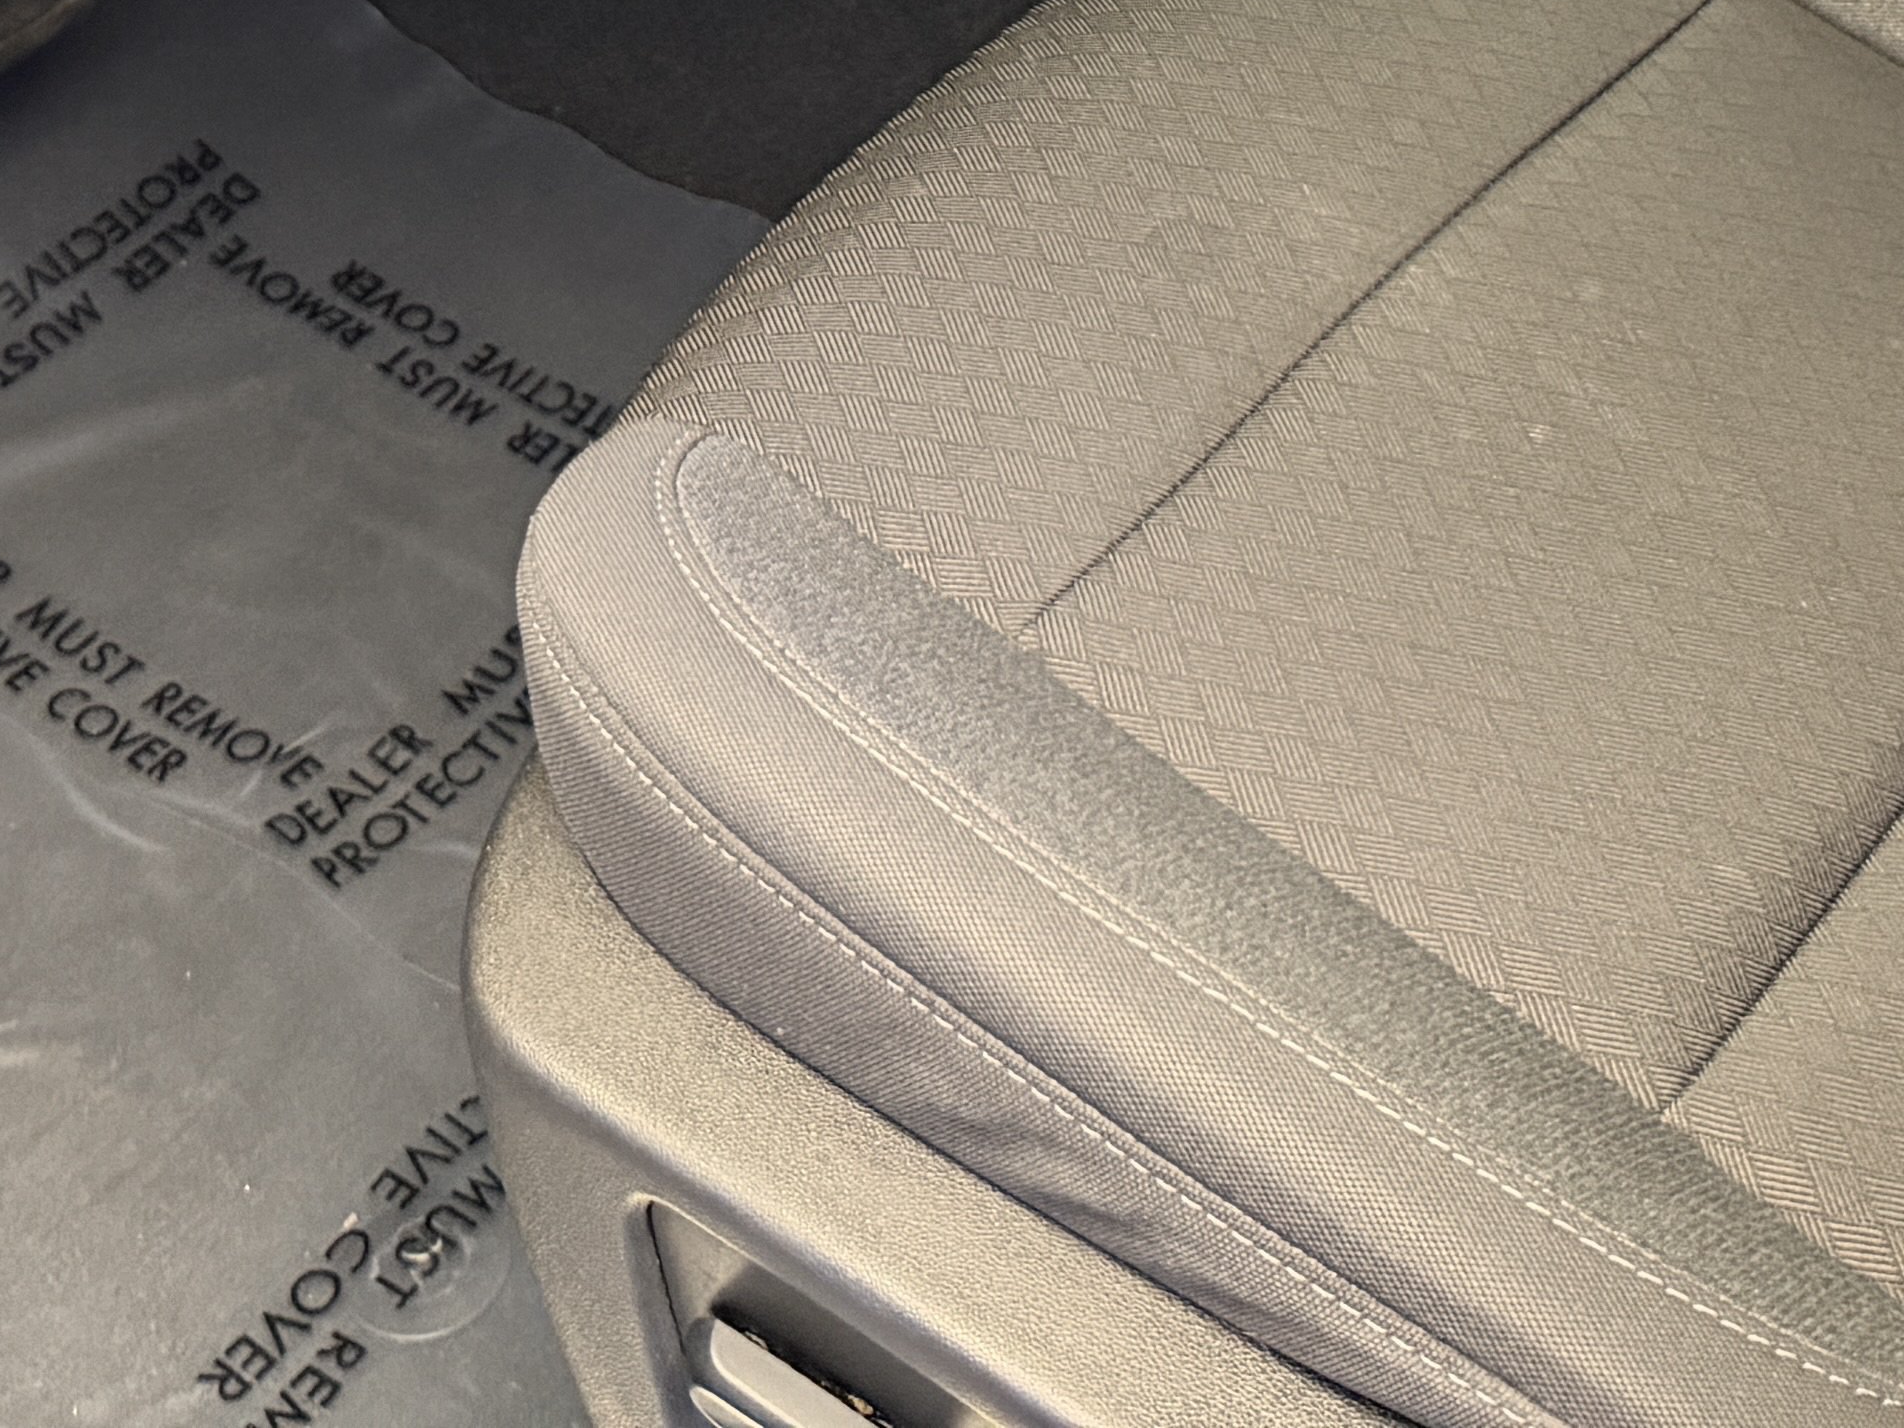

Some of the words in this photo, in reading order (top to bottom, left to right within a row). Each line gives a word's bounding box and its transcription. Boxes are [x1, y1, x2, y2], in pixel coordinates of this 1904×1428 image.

[110, 170, 261, 295] DEALER
[208, 234, 376, 351] REMOVE
[329, 258, 461, 350] COVER
[373, 344, 499, 427] MUST
[460, 341, 614, 440] TECTIVE
[15, 596, 146, 687] MUST
[139, 680, 325, 790] REMOVE
[47, 685, 188, 784] COVER
[264, 723, 434, 847] DEALER
[310, 685, 534, 889] PROTECTIV
[374, 1164, 508, 1311] MUST
[198, 1227, 372, 1403] COVER
